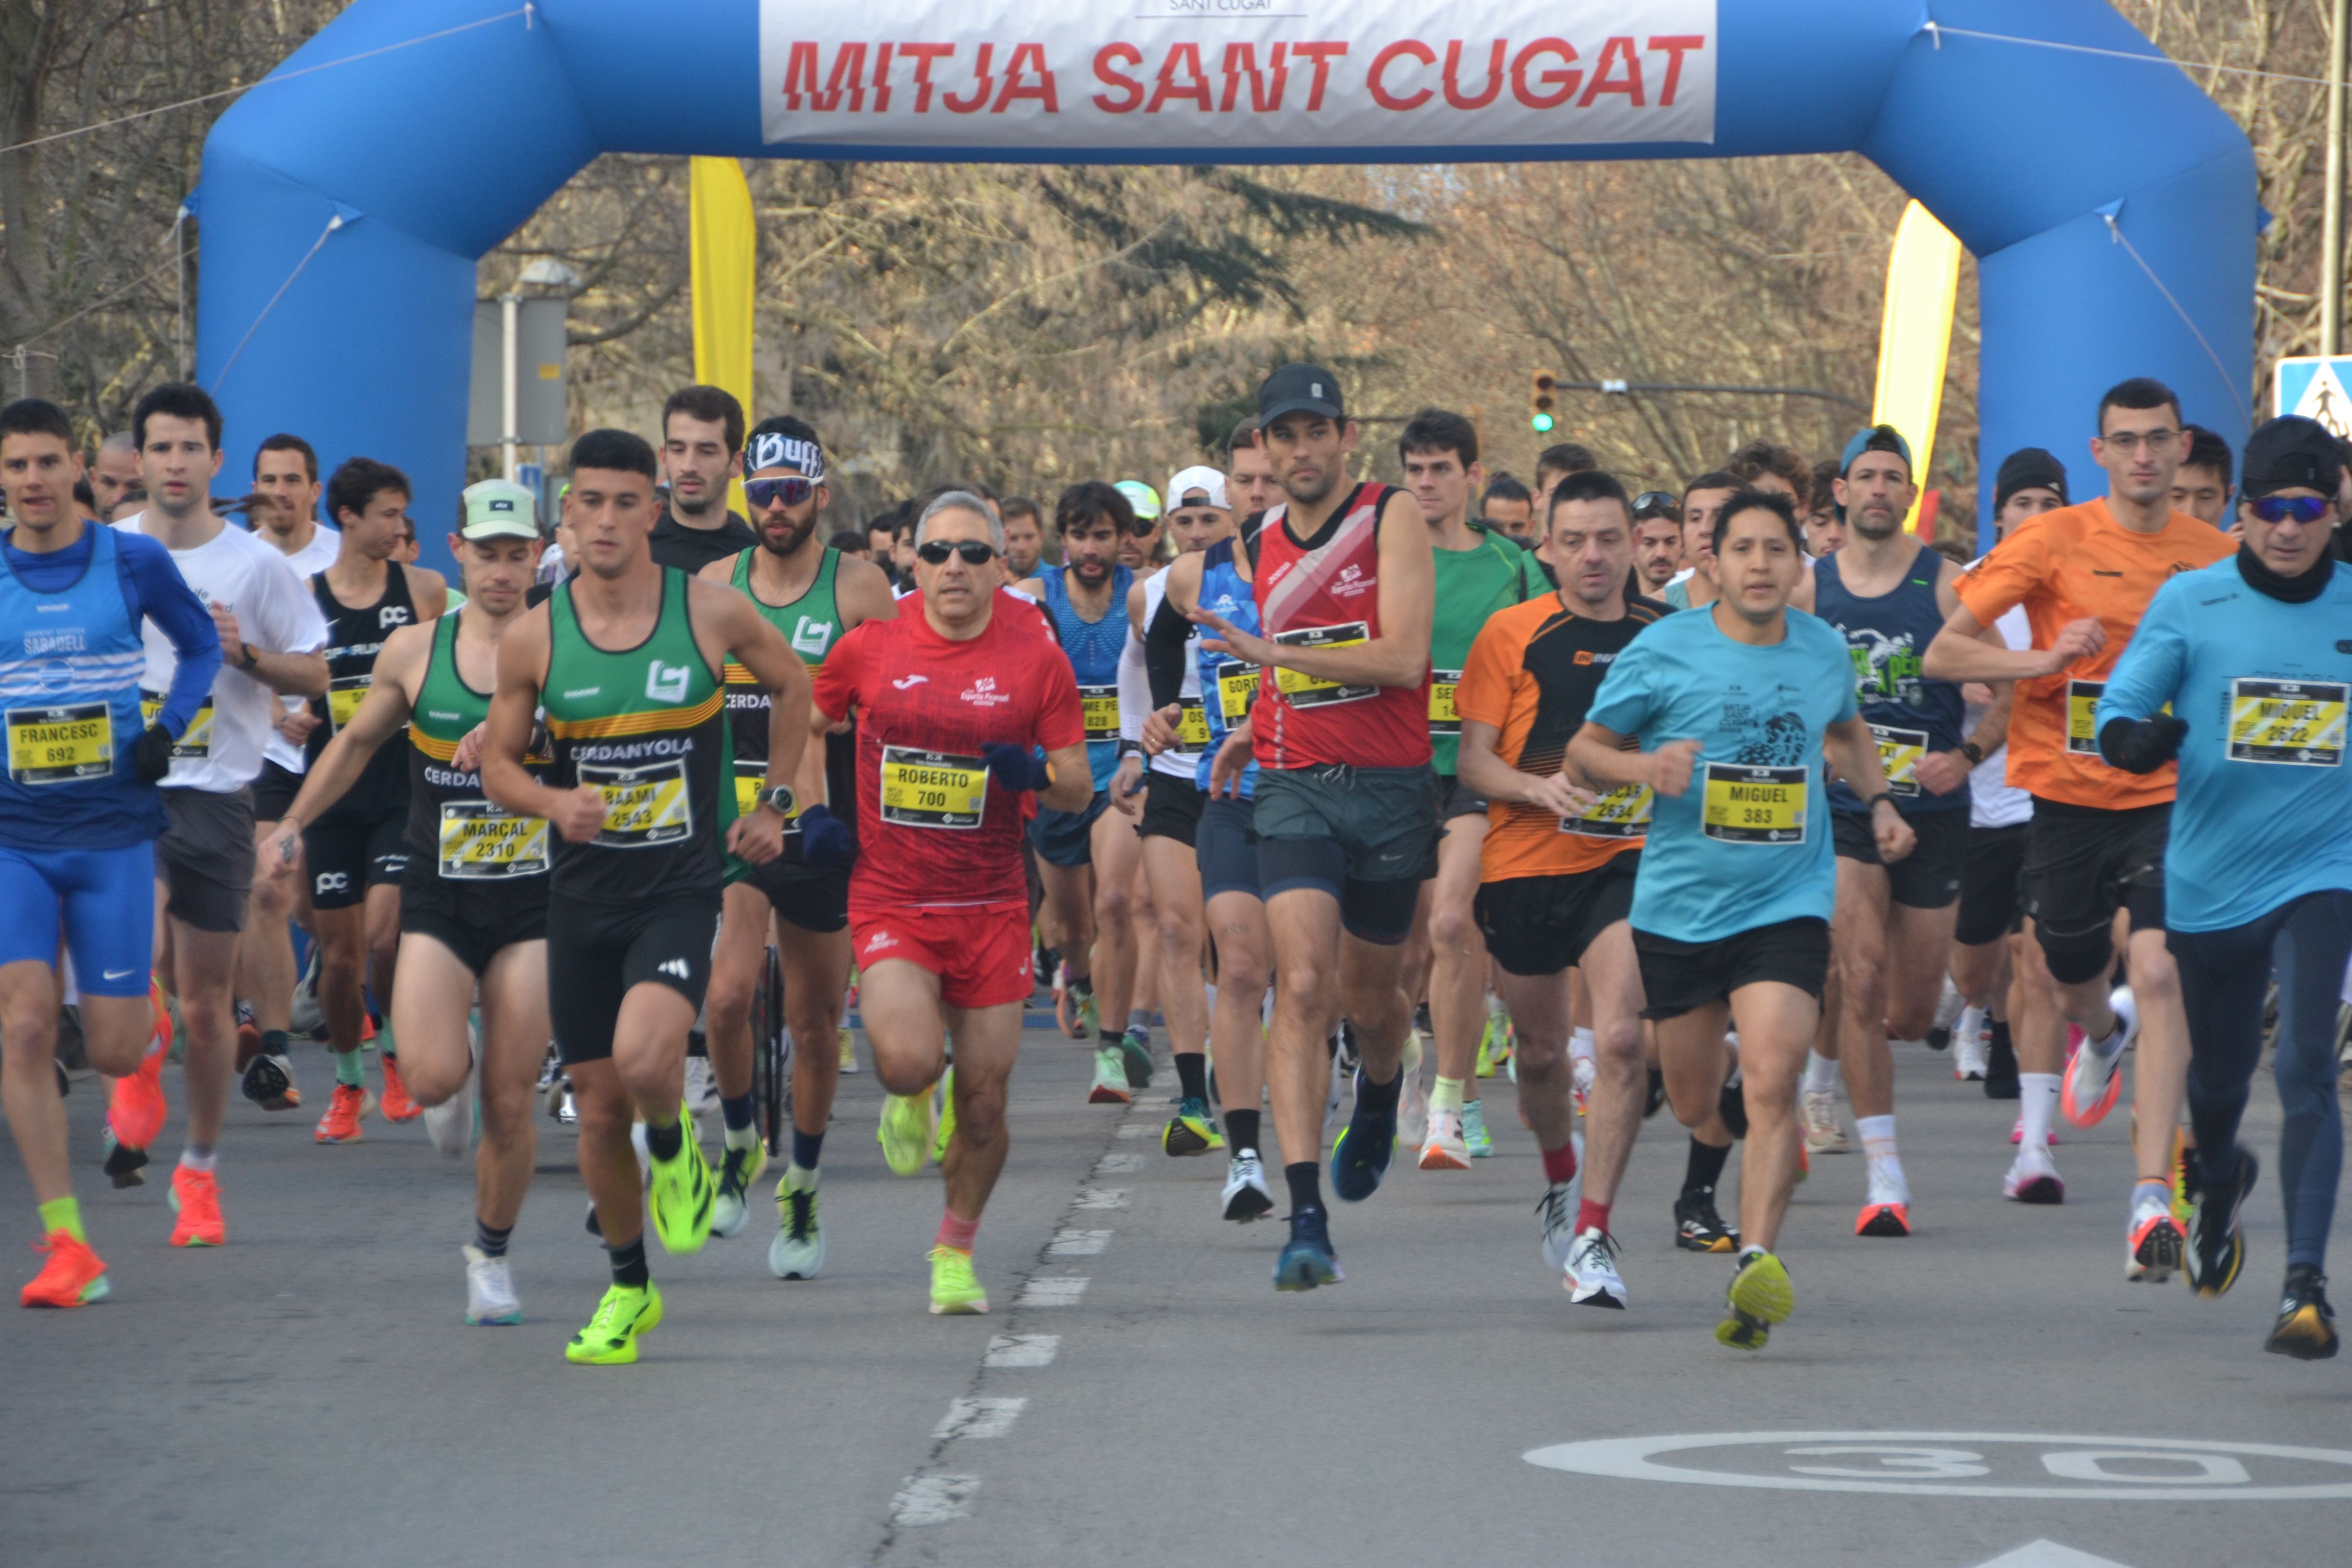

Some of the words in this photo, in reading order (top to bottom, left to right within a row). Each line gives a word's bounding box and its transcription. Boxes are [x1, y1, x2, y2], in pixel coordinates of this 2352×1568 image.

[781, 41, 1060, 114] MITJA
[1091, 40, 1348, 114] SANT
[1365, 35, 1706, 111] CUGAT
[20, 723, 98, 744] FRANCESC
[46, 747, 75, 762] 692
[898, 768, 969, 788] ROBERTO
[918, 791, 946, 806] 700
[1730, 786, 1788, 803] MIGUEL
[614, 808, 653, 826] 2543
[1743, 808, 1773, 823] 383
[463, 822, 528, 841] MARÇAL
[476, 843, 515, 857] 2310
[1783, 1446, 2251, 1484] 30
